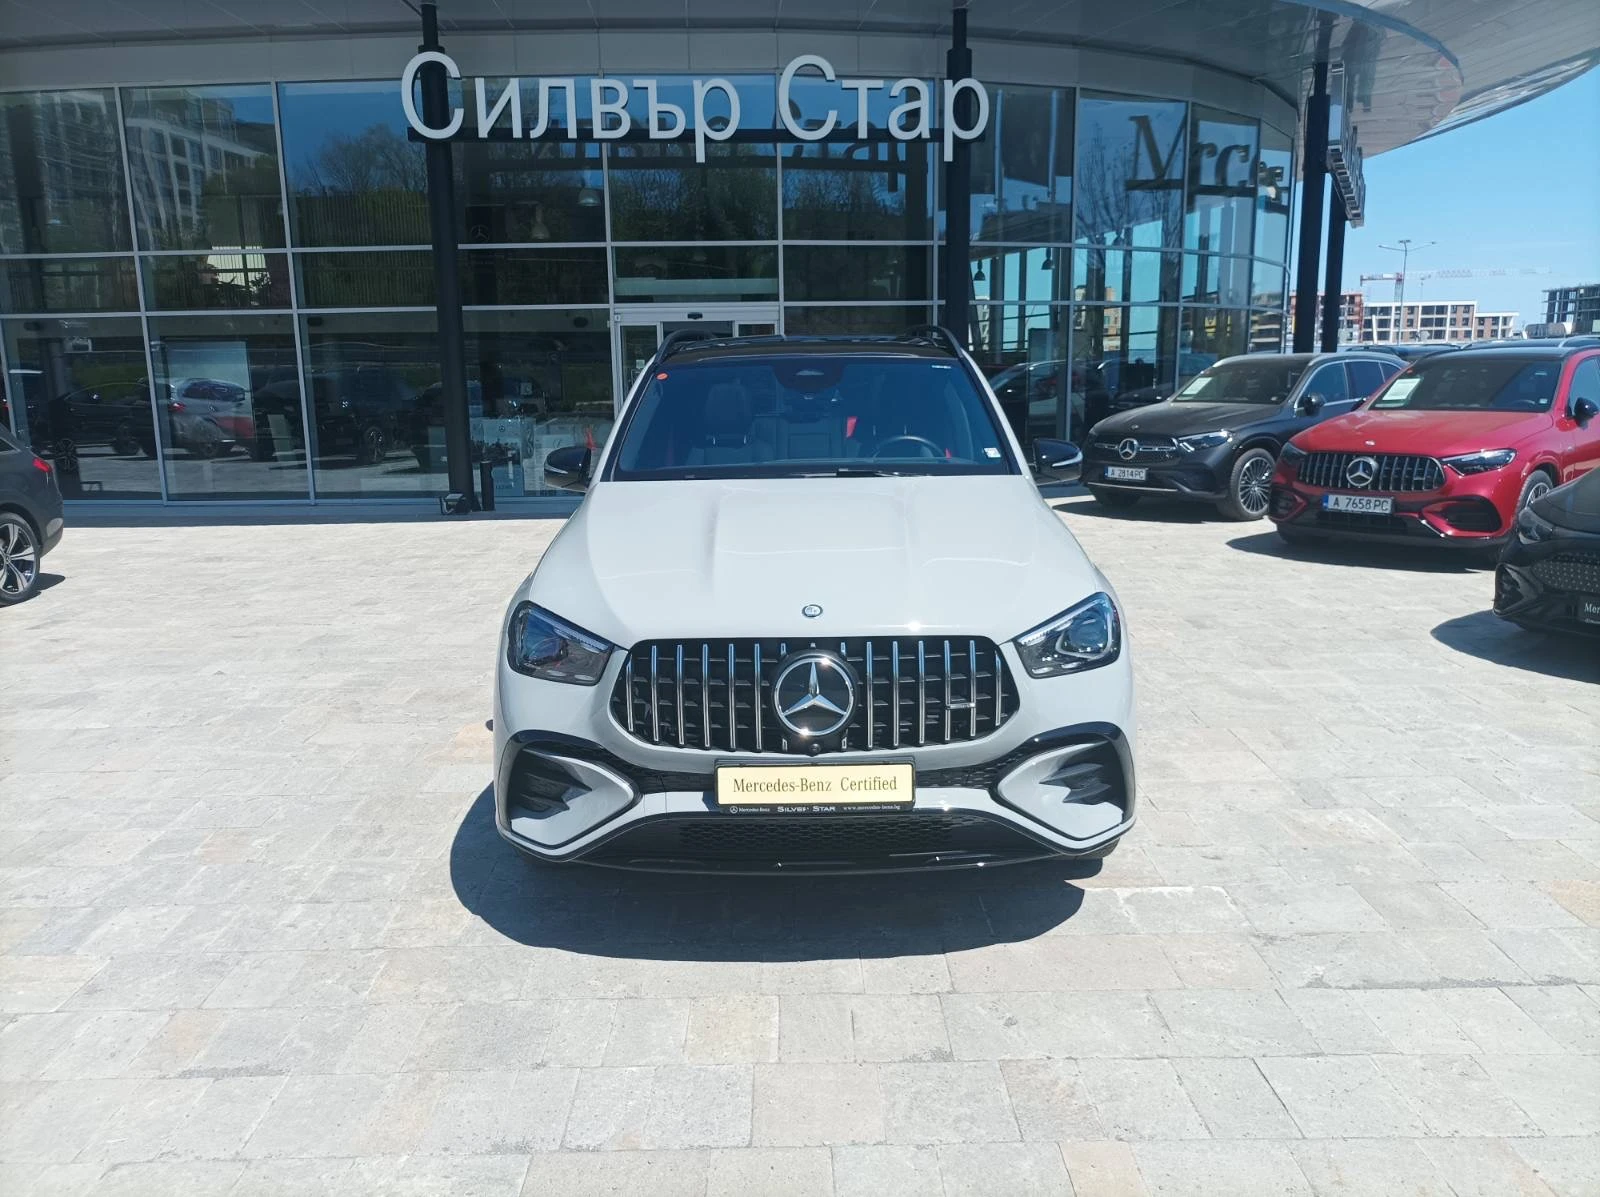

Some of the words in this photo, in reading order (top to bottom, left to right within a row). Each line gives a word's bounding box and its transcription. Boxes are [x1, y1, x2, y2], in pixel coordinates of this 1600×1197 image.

[401, 51, 742, 164] Силвър
[778, 54, 990, 162] Стар
[733, 778, 832, 793] Mercedes-Benz
[840, 776, 898, 791] Certified
